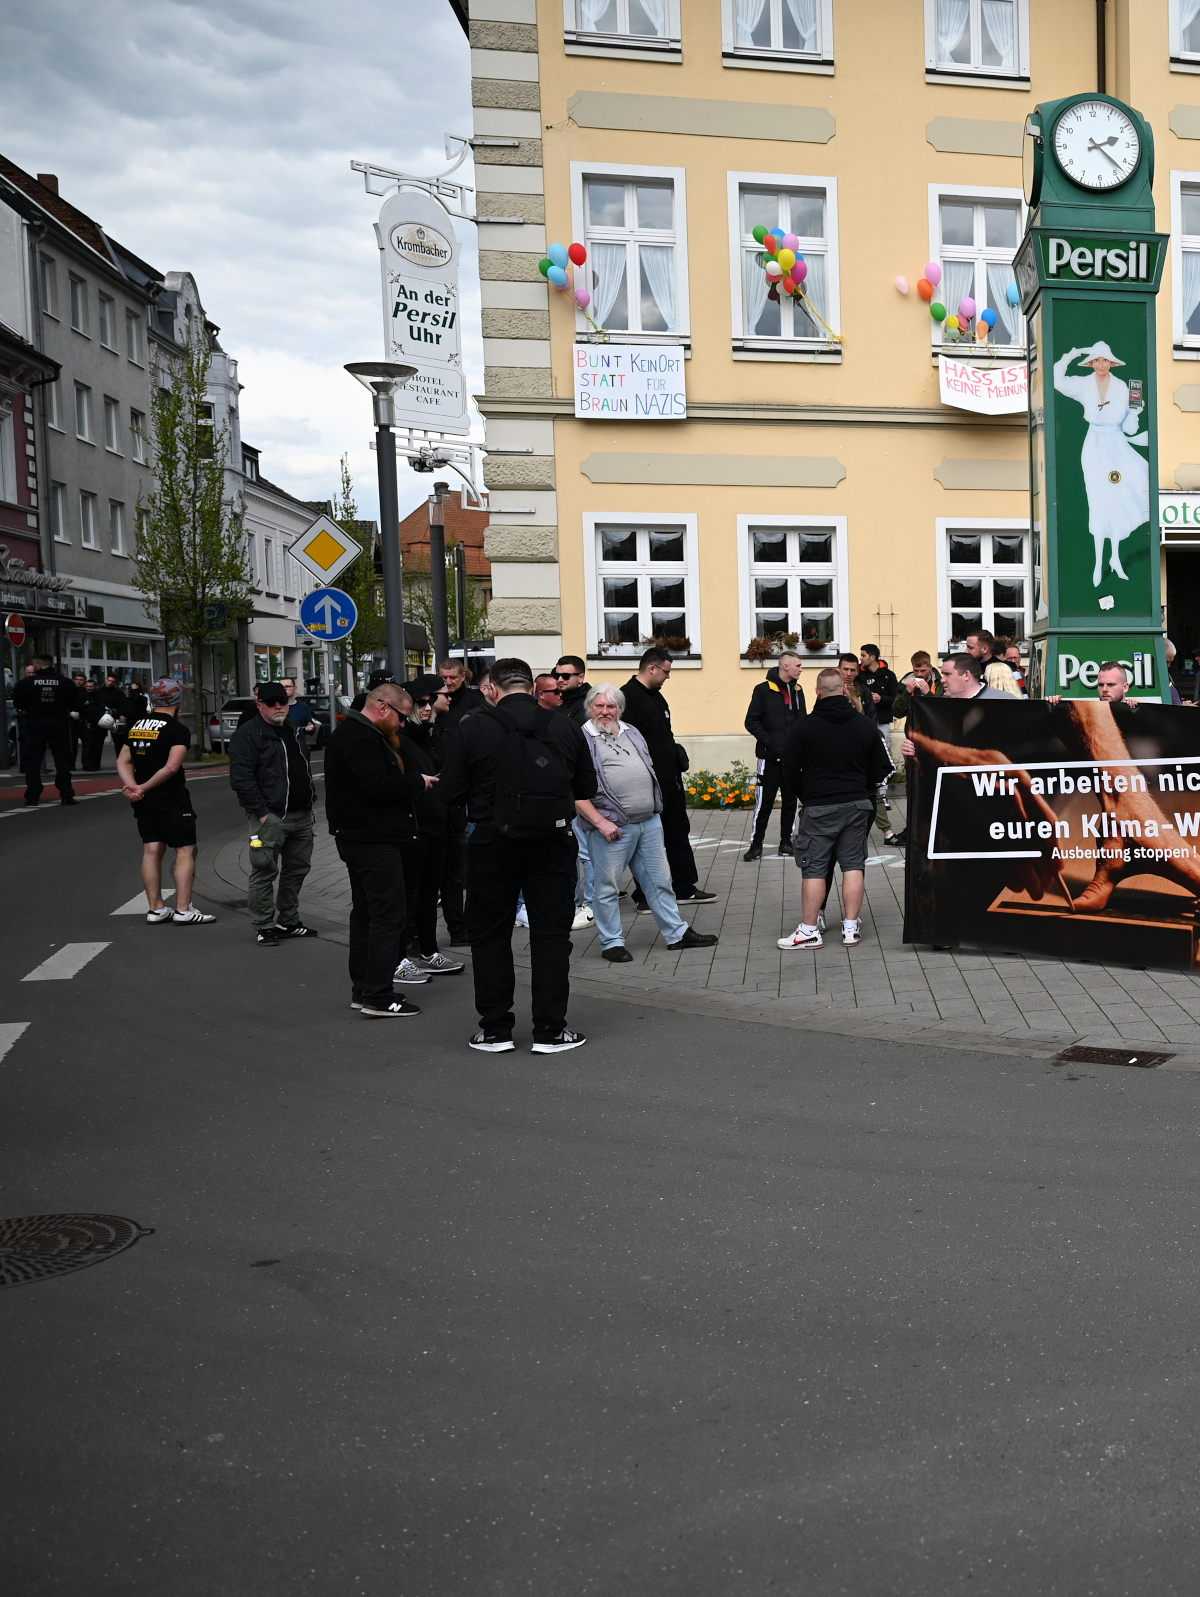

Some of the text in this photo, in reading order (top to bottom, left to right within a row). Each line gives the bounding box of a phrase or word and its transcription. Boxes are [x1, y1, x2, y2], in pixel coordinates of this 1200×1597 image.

[1089, 111, 1097, 119] 12
[1065, 127, 1074, 135] 10
[396, 236, 448, 259] Krombacher
[1048, 238, 1148, 279] Persil
[397, 284, 451, 307] An der
[392, 301, 457, 329] Persil
[409, 324, 442, 345] Uhr
[577, 350, 623, 369] BUNT
[630, 353, 681, 373] KEIN ORT
[580, 372, 626, 390] STATT
[945, 360, 1028, 387] HASS IST
[401, 382, 460, 399] ESTAURANT
[946, 376, 1029, 400] KEINE MEINUN
[580, 391, 629, 413] BRAUN
[635, 392, 687, 417] NAZIS
[972, 772, 1017, 798] Wir
[1030, 767, 1147, 796] arbeiten
[989, 816, 1071, 841] euren
[1051, 847, 1198, 863] Ausbeutung stoppen !
